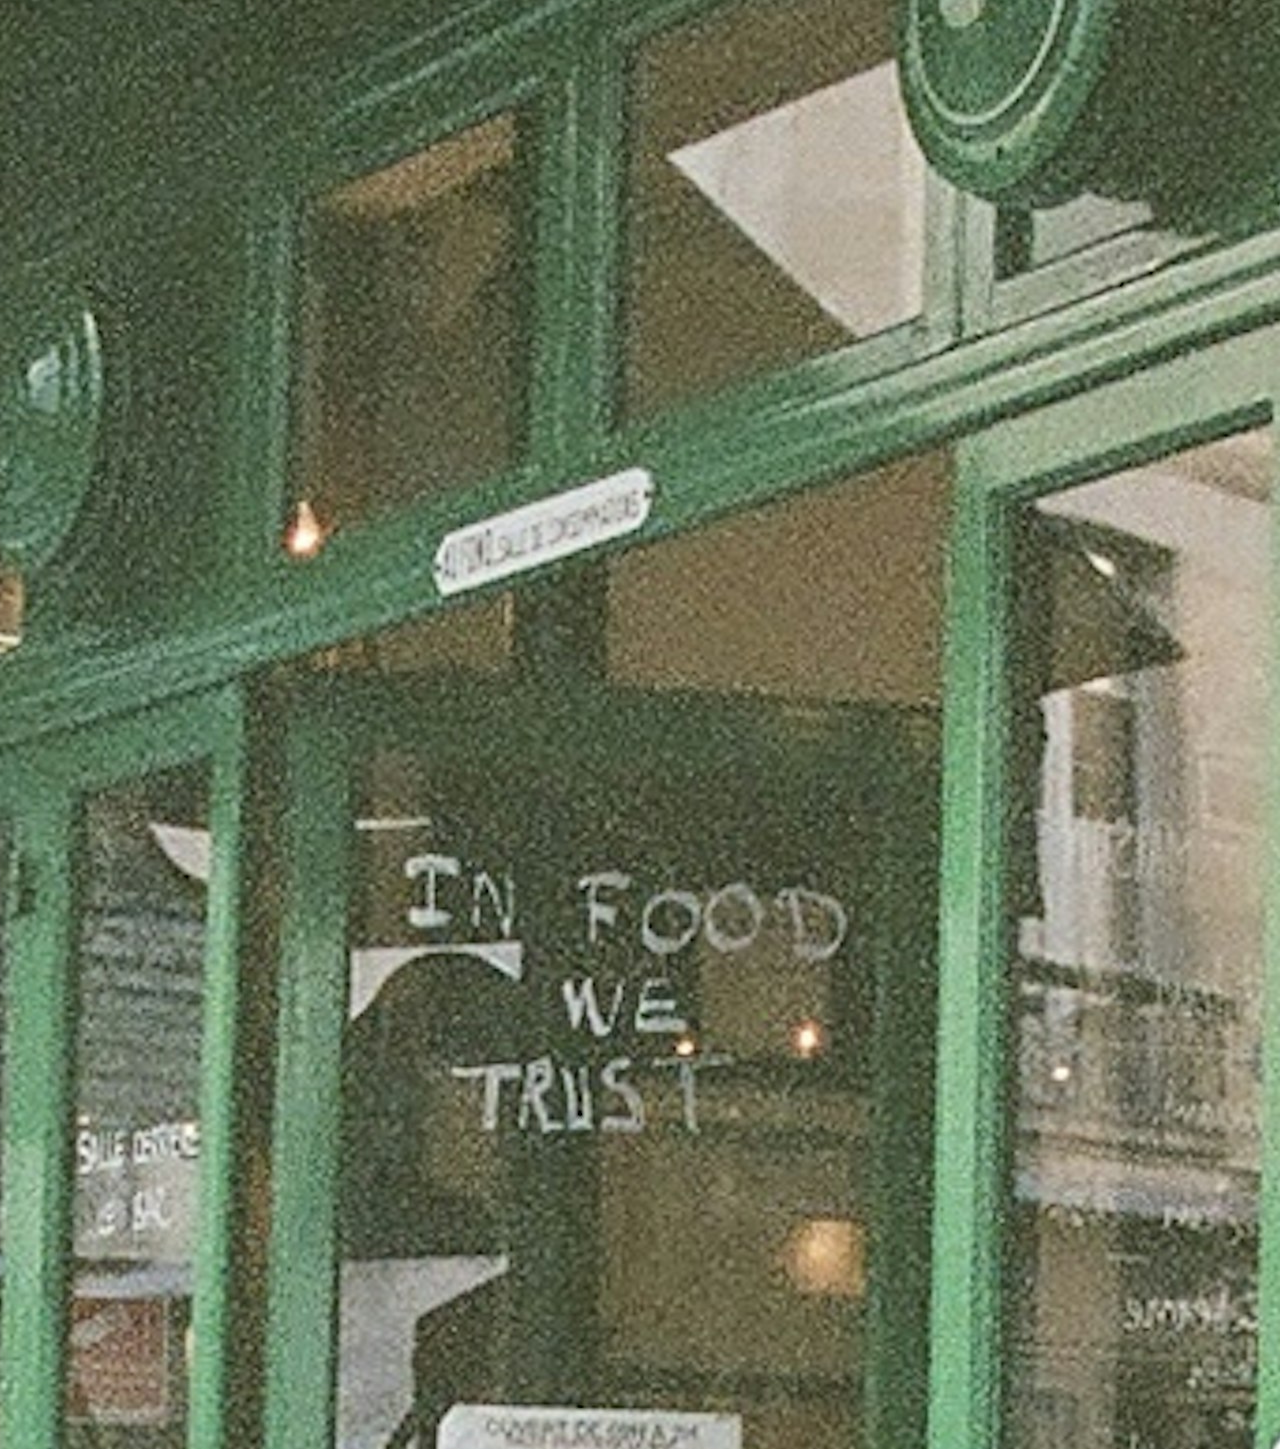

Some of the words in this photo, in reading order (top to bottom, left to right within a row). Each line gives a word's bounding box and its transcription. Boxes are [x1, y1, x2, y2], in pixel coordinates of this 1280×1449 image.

[404, 852, 516, 940] IN
[578, 867, 850, 961] FOOD
[561, 976, 689, 1038] WE
[450, 1052, 736, 1137] TRUST
